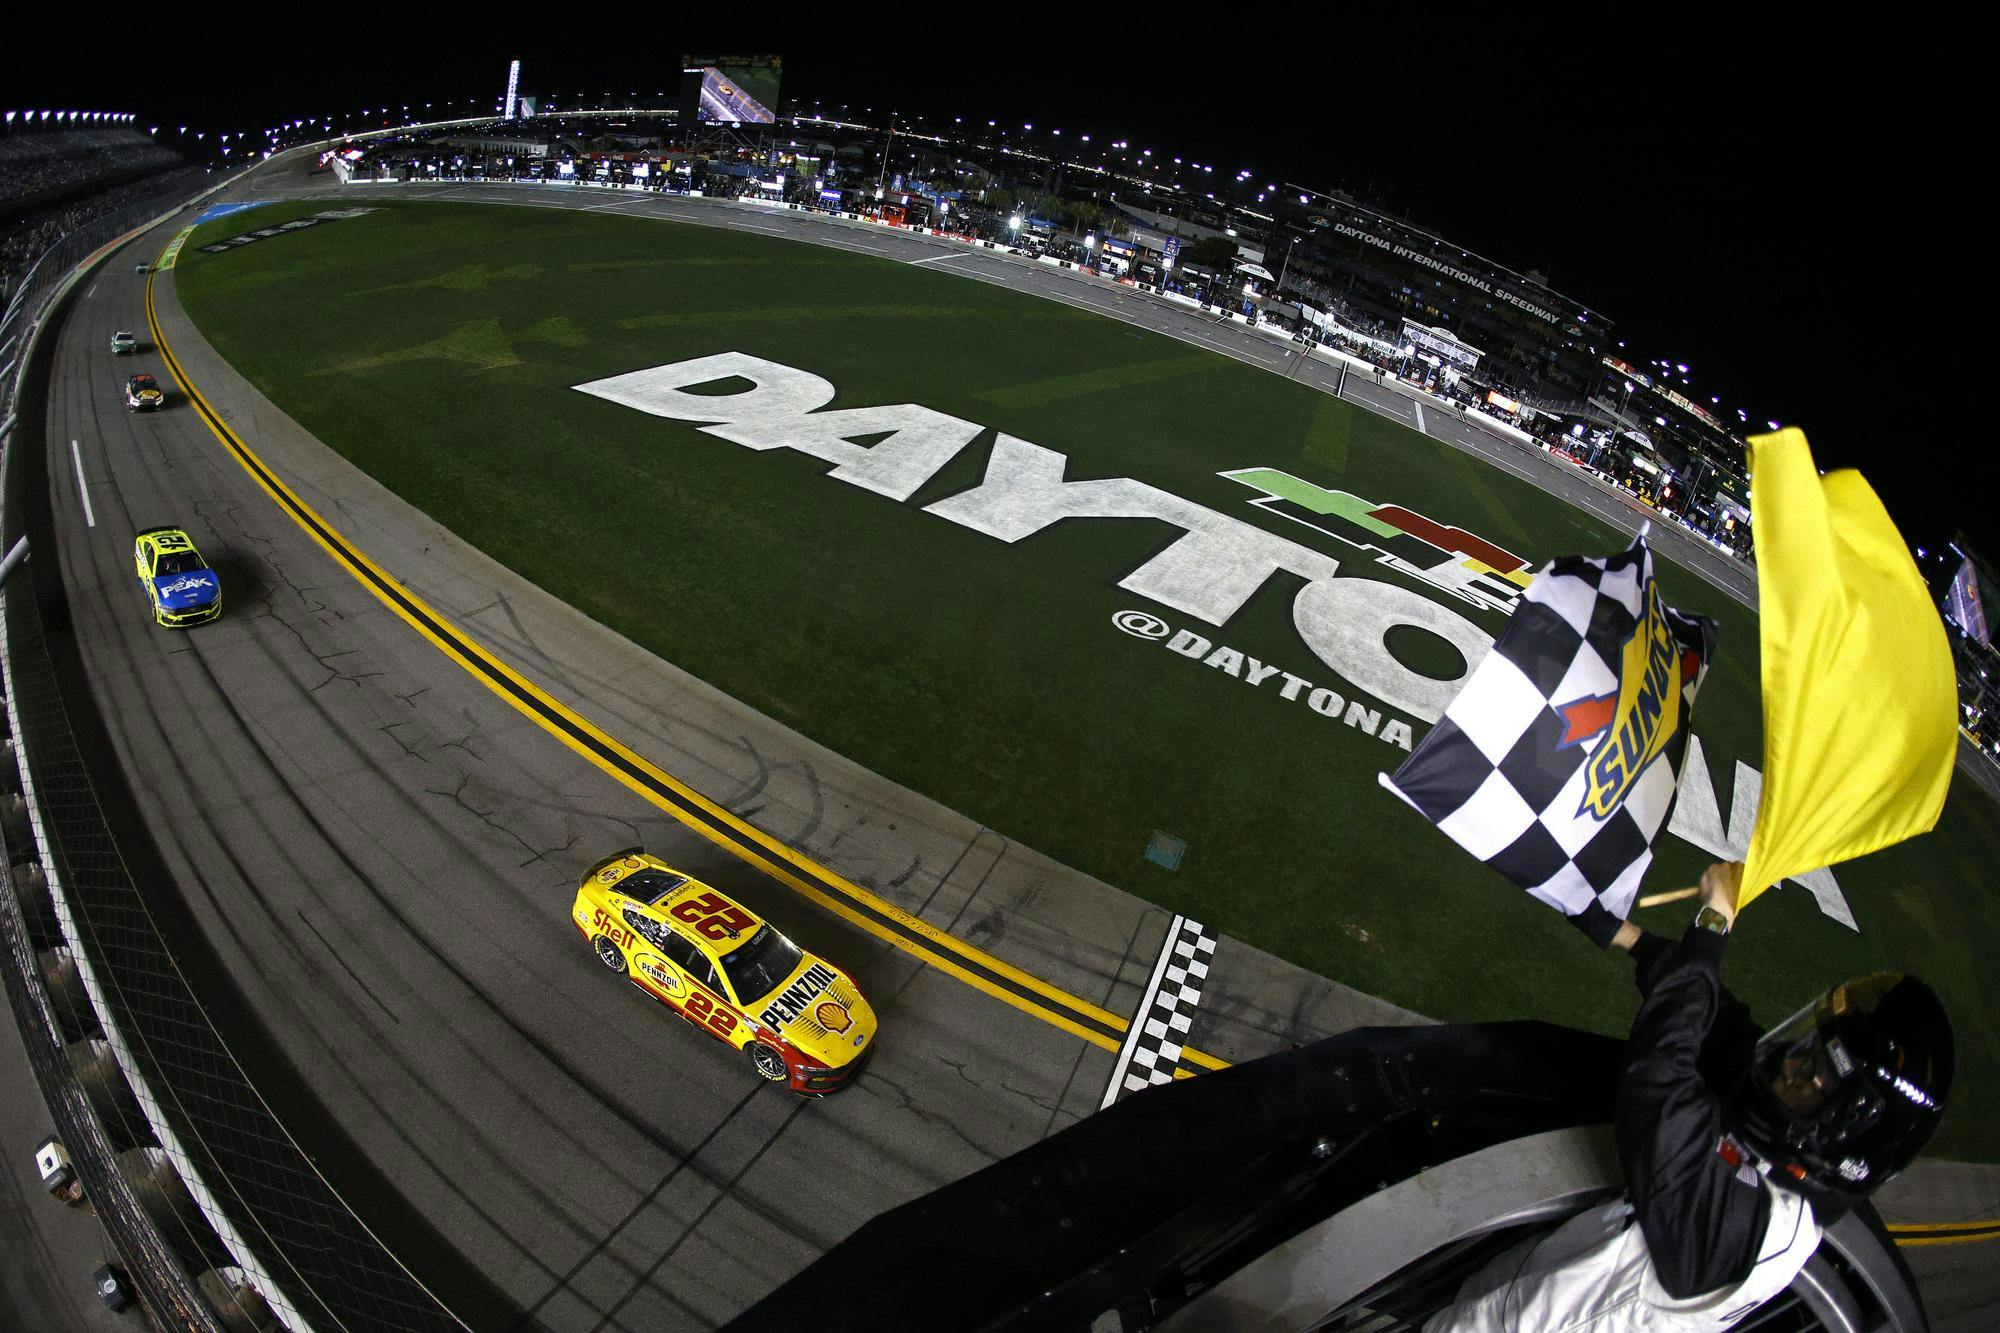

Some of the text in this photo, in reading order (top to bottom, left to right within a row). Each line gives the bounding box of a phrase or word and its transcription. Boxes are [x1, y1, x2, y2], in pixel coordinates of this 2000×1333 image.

[1334, 223, 1561, 325] DAYTONA INTERNATIONAL SPEEDWAY
[1372, 340, 1390, 353] Mobil
[160, 578, 214, 599] PEAK
[1111, 609, 1413, 752] @DAYTONA
[593, 908, 636, 950] Shell
[670, 892, 758, 941] 22
[641, 962, 679, 989] PENNZOIL
[759, 963, 838, 1034] PENNZOIL
[684, 991, 738, 1037] 22
